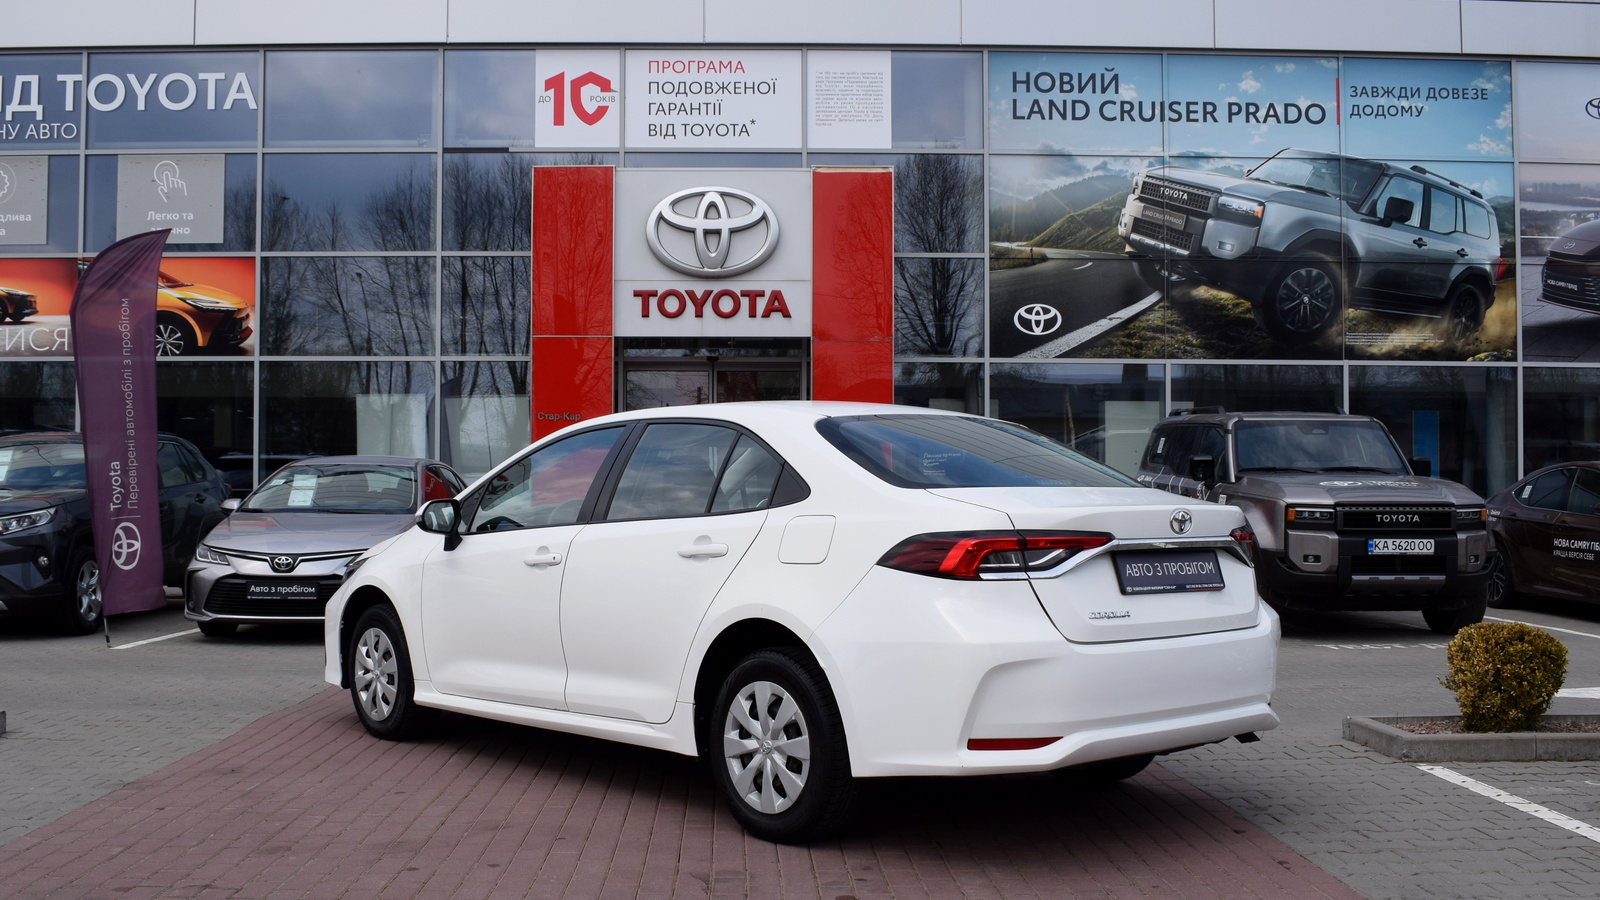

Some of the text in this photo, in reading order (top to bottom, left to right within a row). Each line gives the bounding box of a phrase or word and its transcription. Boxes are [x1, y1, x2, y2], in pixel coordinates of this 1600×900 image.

[647, 60, 746, 74] ПРОГРАМА
[648, 78, 777, 97] ПОДОВЖЕНОЇ
[1011, 67, 1120, 95] НОВИЙ
[57, 72, 258, 112] TOYOTA
[538, 71, 616, 126] ДО 10 РОКІВ
[1349, 85, 1488, 101] ЗАВЖДИ ДОВЕЗЕ
[648, 99, 723, 116] ГАРАНТІЇ
[1012, 98, 1327, 125] LAND CRUISER PRADO
[1349, 104, 1424, 119] ДОДОМУ
[25, 122, 78, 140] АВТО
[648, 123, 677, 139] ВІД
[1160, 187, 1188, 199] TOYOTA
[146, 211, 179, 221] Легко
[633, 289, 792, 319] TOYOTA
[118, 298, 133, 356] пробігом
[0, 327, 68, 351] ИСЯ
[122, 369, 135, 437] автомобілі
[537, 411, 581, 422] Стар-Кар
[126, 440, 139, 509] Перевірені
[109, 461, 124, 511] Toyota
[1375, 514, 1421, 522] TOYOTA
[1374, 540, 1389, 551] KA
[1391, 540, 1416, 551] 5620
[1553, 539, 1600, 551] НОВА CAMRY ГІБ
[1126, 563, 1153, 577] АВТО
[1163, 561, 1216, 575] ПРОБІГОМ
[249, 584, 269, 593] Авто
[277, 584, 316, 595] пробігом
